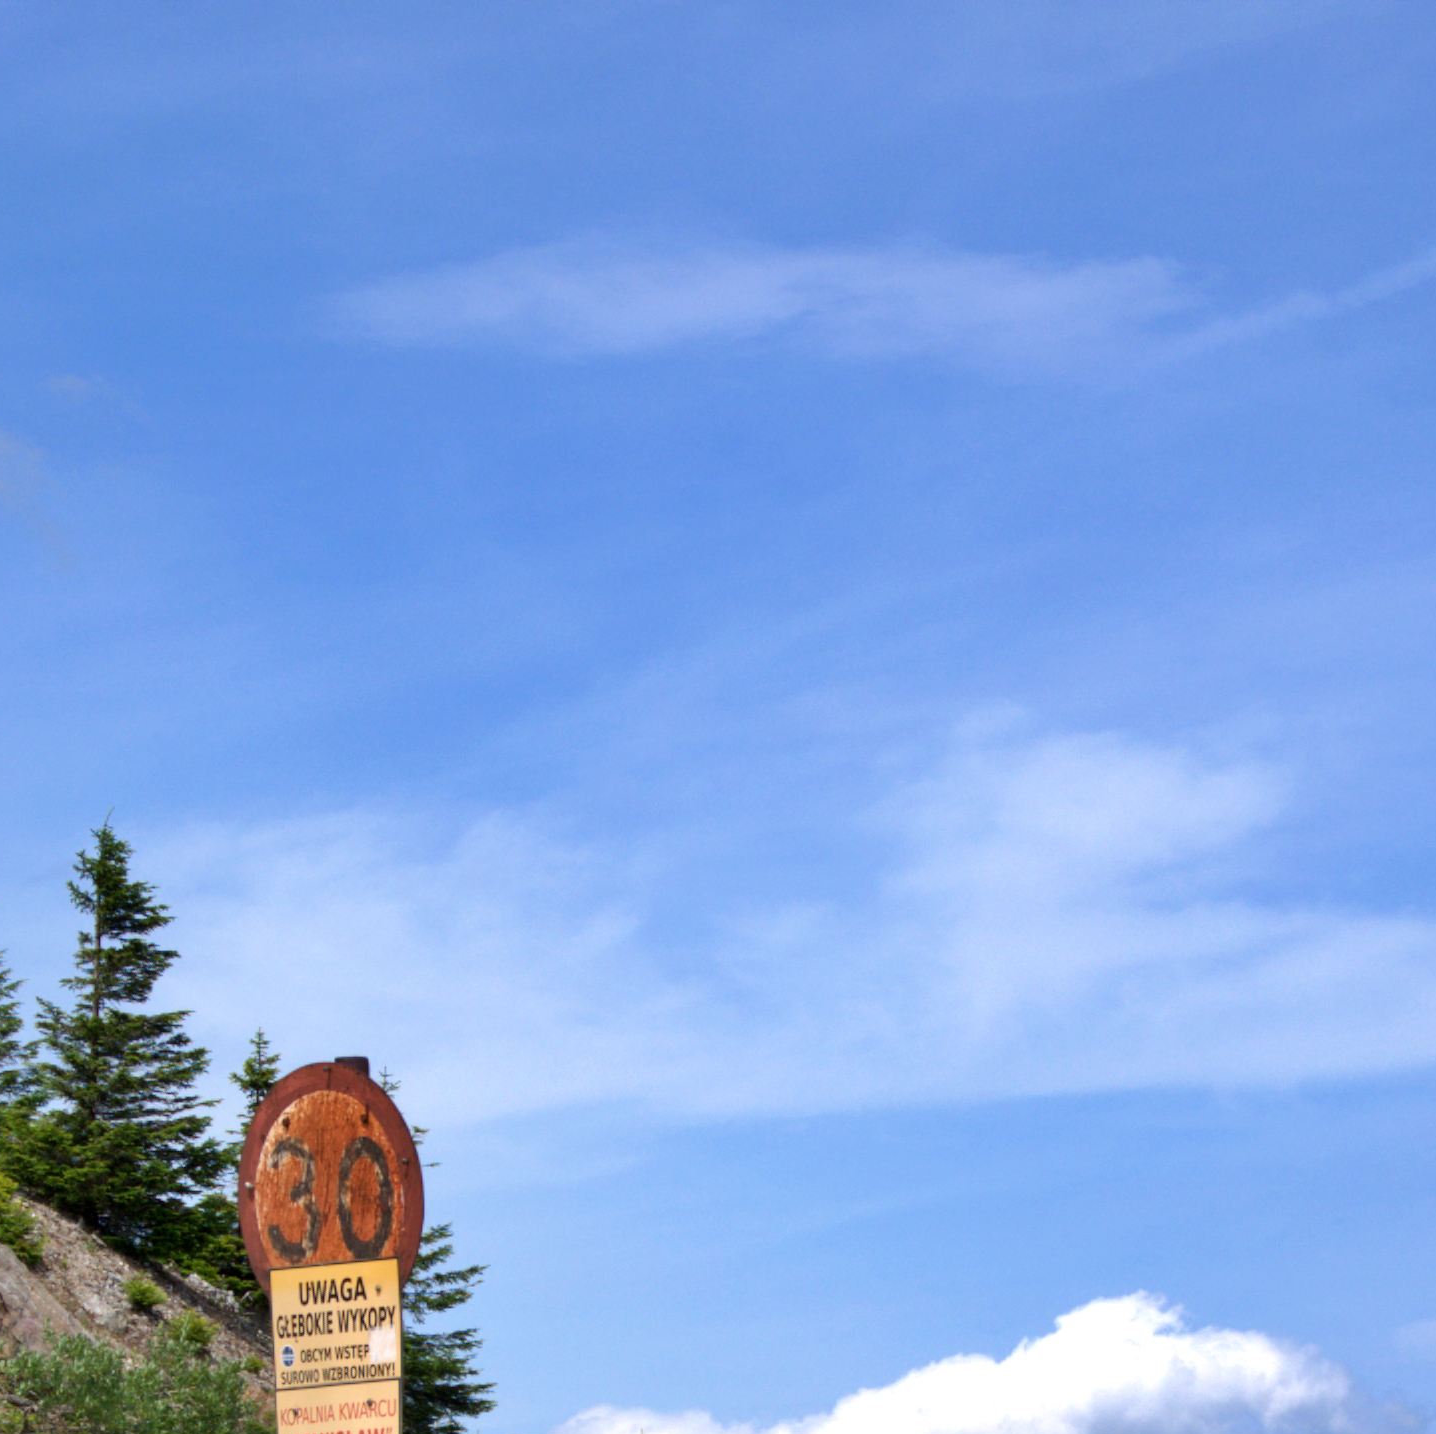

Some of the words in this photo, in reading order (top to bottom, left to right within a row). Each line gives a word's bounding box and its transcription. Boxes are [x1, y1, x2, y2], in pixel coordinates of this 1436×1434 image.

[267, 1136, 394, 1262] 30
[298, 1276, 367, 1306] UWAGA
[276, 1310, 333, 1342] GŁĘBOKIE
[337, 1305, 396, 1333] WYKOPY
[300, 1347, 332, 1363] OBCYM
[334, 1344, 370, 1361] WSTĘP
[281, 1367, 320, 1385] SUROWO
[322, 1362, 396, 1381] WZBRONIONY!
[280, 1404, 335, 1426] KOPALNIA
[339, 1398, 397, 1421] KWARCU
